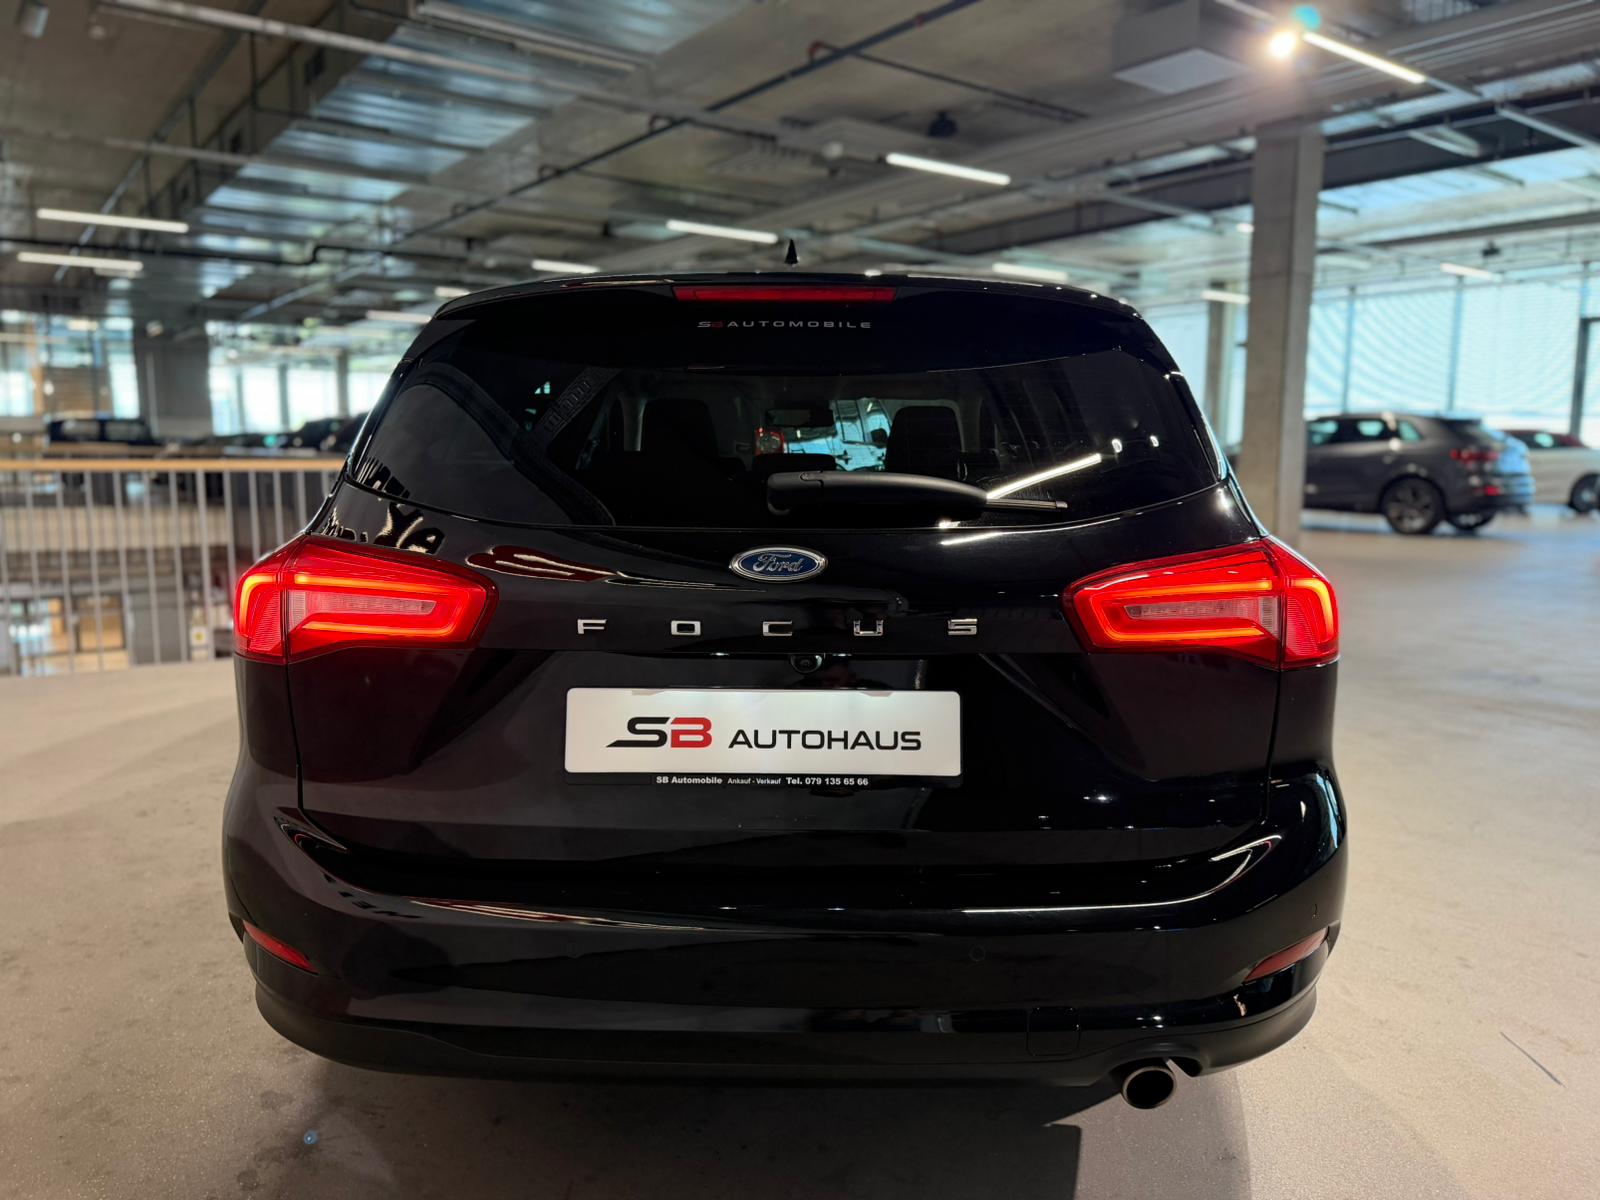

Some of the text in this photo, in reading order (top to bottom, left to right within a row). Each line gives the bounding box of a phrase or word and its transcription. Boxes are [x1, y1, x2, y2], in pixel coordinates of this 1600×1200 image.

[727, 320, 873, 329] AUTOMOBILE
[752, 553, 805, 572] Ford
[577, 618, 978, 637] FOCUS
[605, 716, 922, 751] SB AUTOHAUS
[656, 776, 669, 784] SB
[671, 776, 723, 785] Automobile
[785, 777, 803, 785] Tel.
[805, 777, 822, 786] 079
[824, 778, 841, 786] 135
[843, 778, 855, 786] 65
[857, 778, 869, 786] 66
